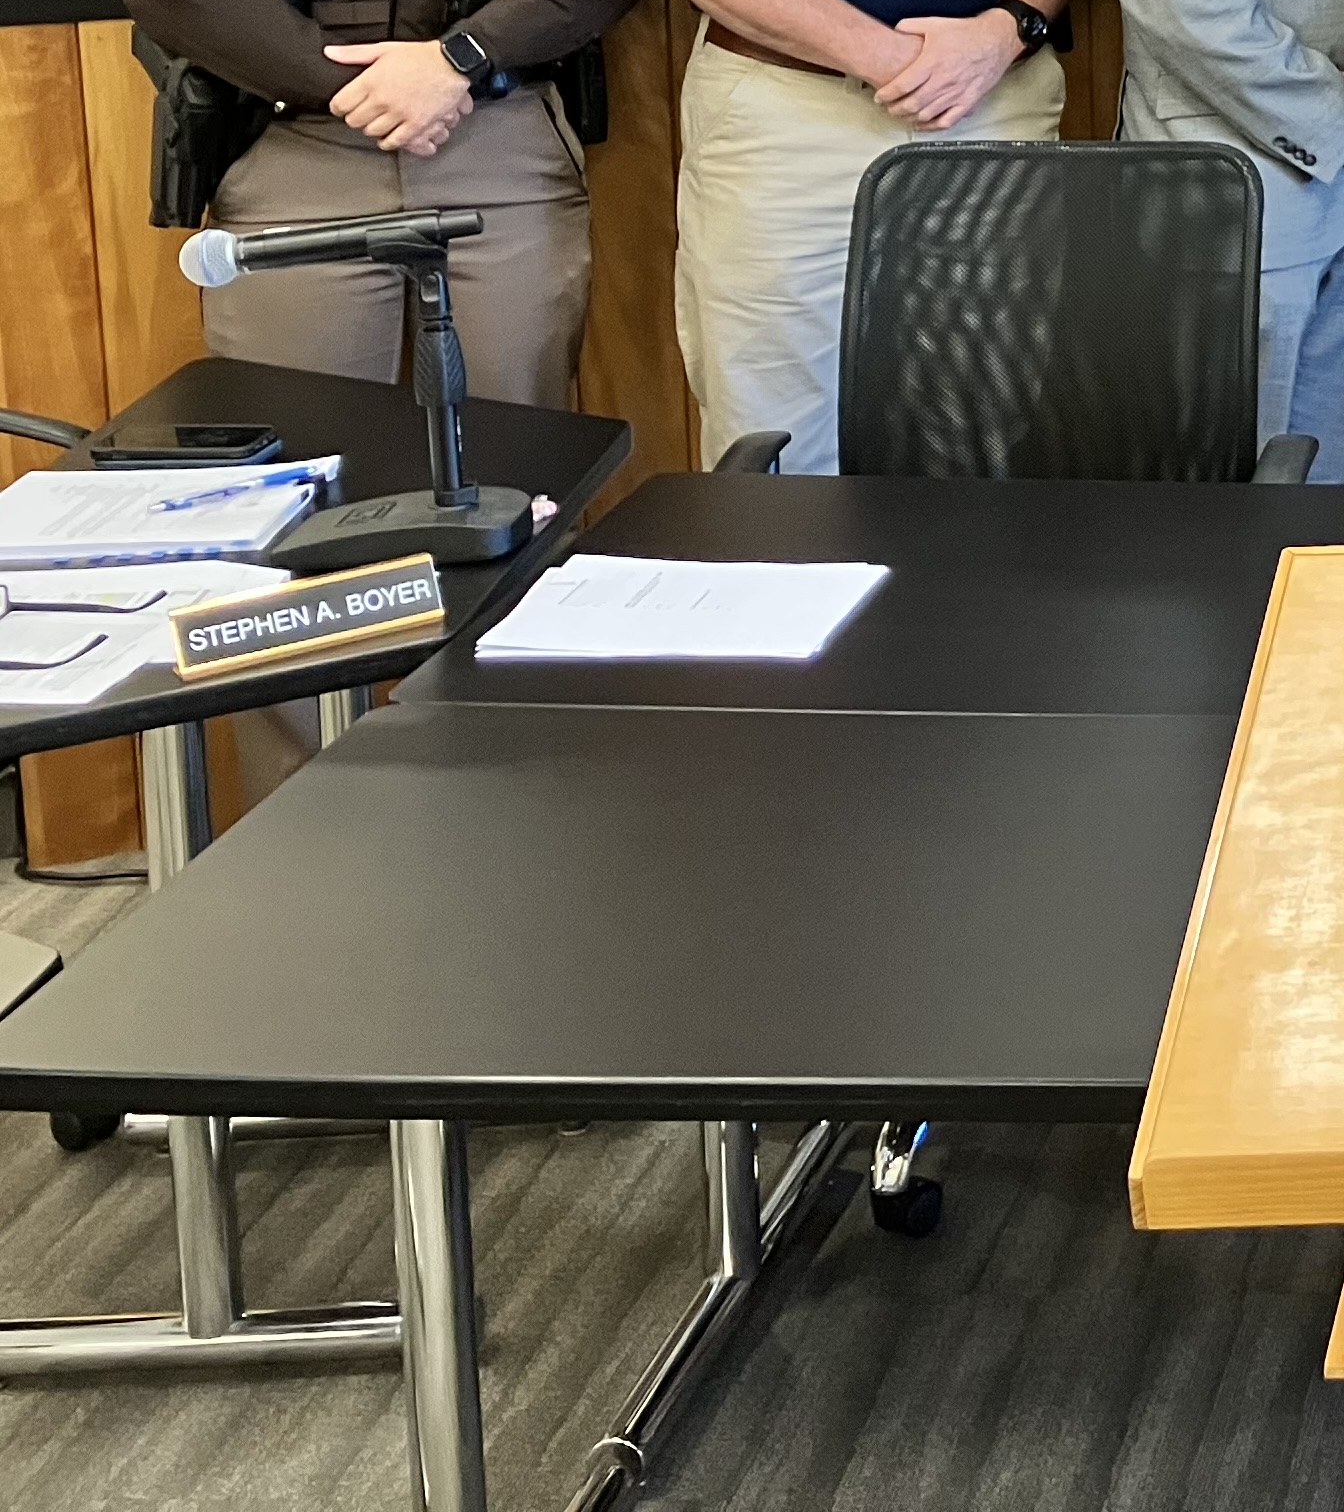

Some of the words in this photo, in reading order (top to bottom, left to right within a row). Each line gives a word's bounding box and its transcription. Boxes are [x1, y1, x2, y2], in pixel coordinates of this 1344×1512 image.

[188, 607, 310, 652] STEPHEN
[316, 600, 341, 624] A.
[345, 578, 432, 616] BOYER
